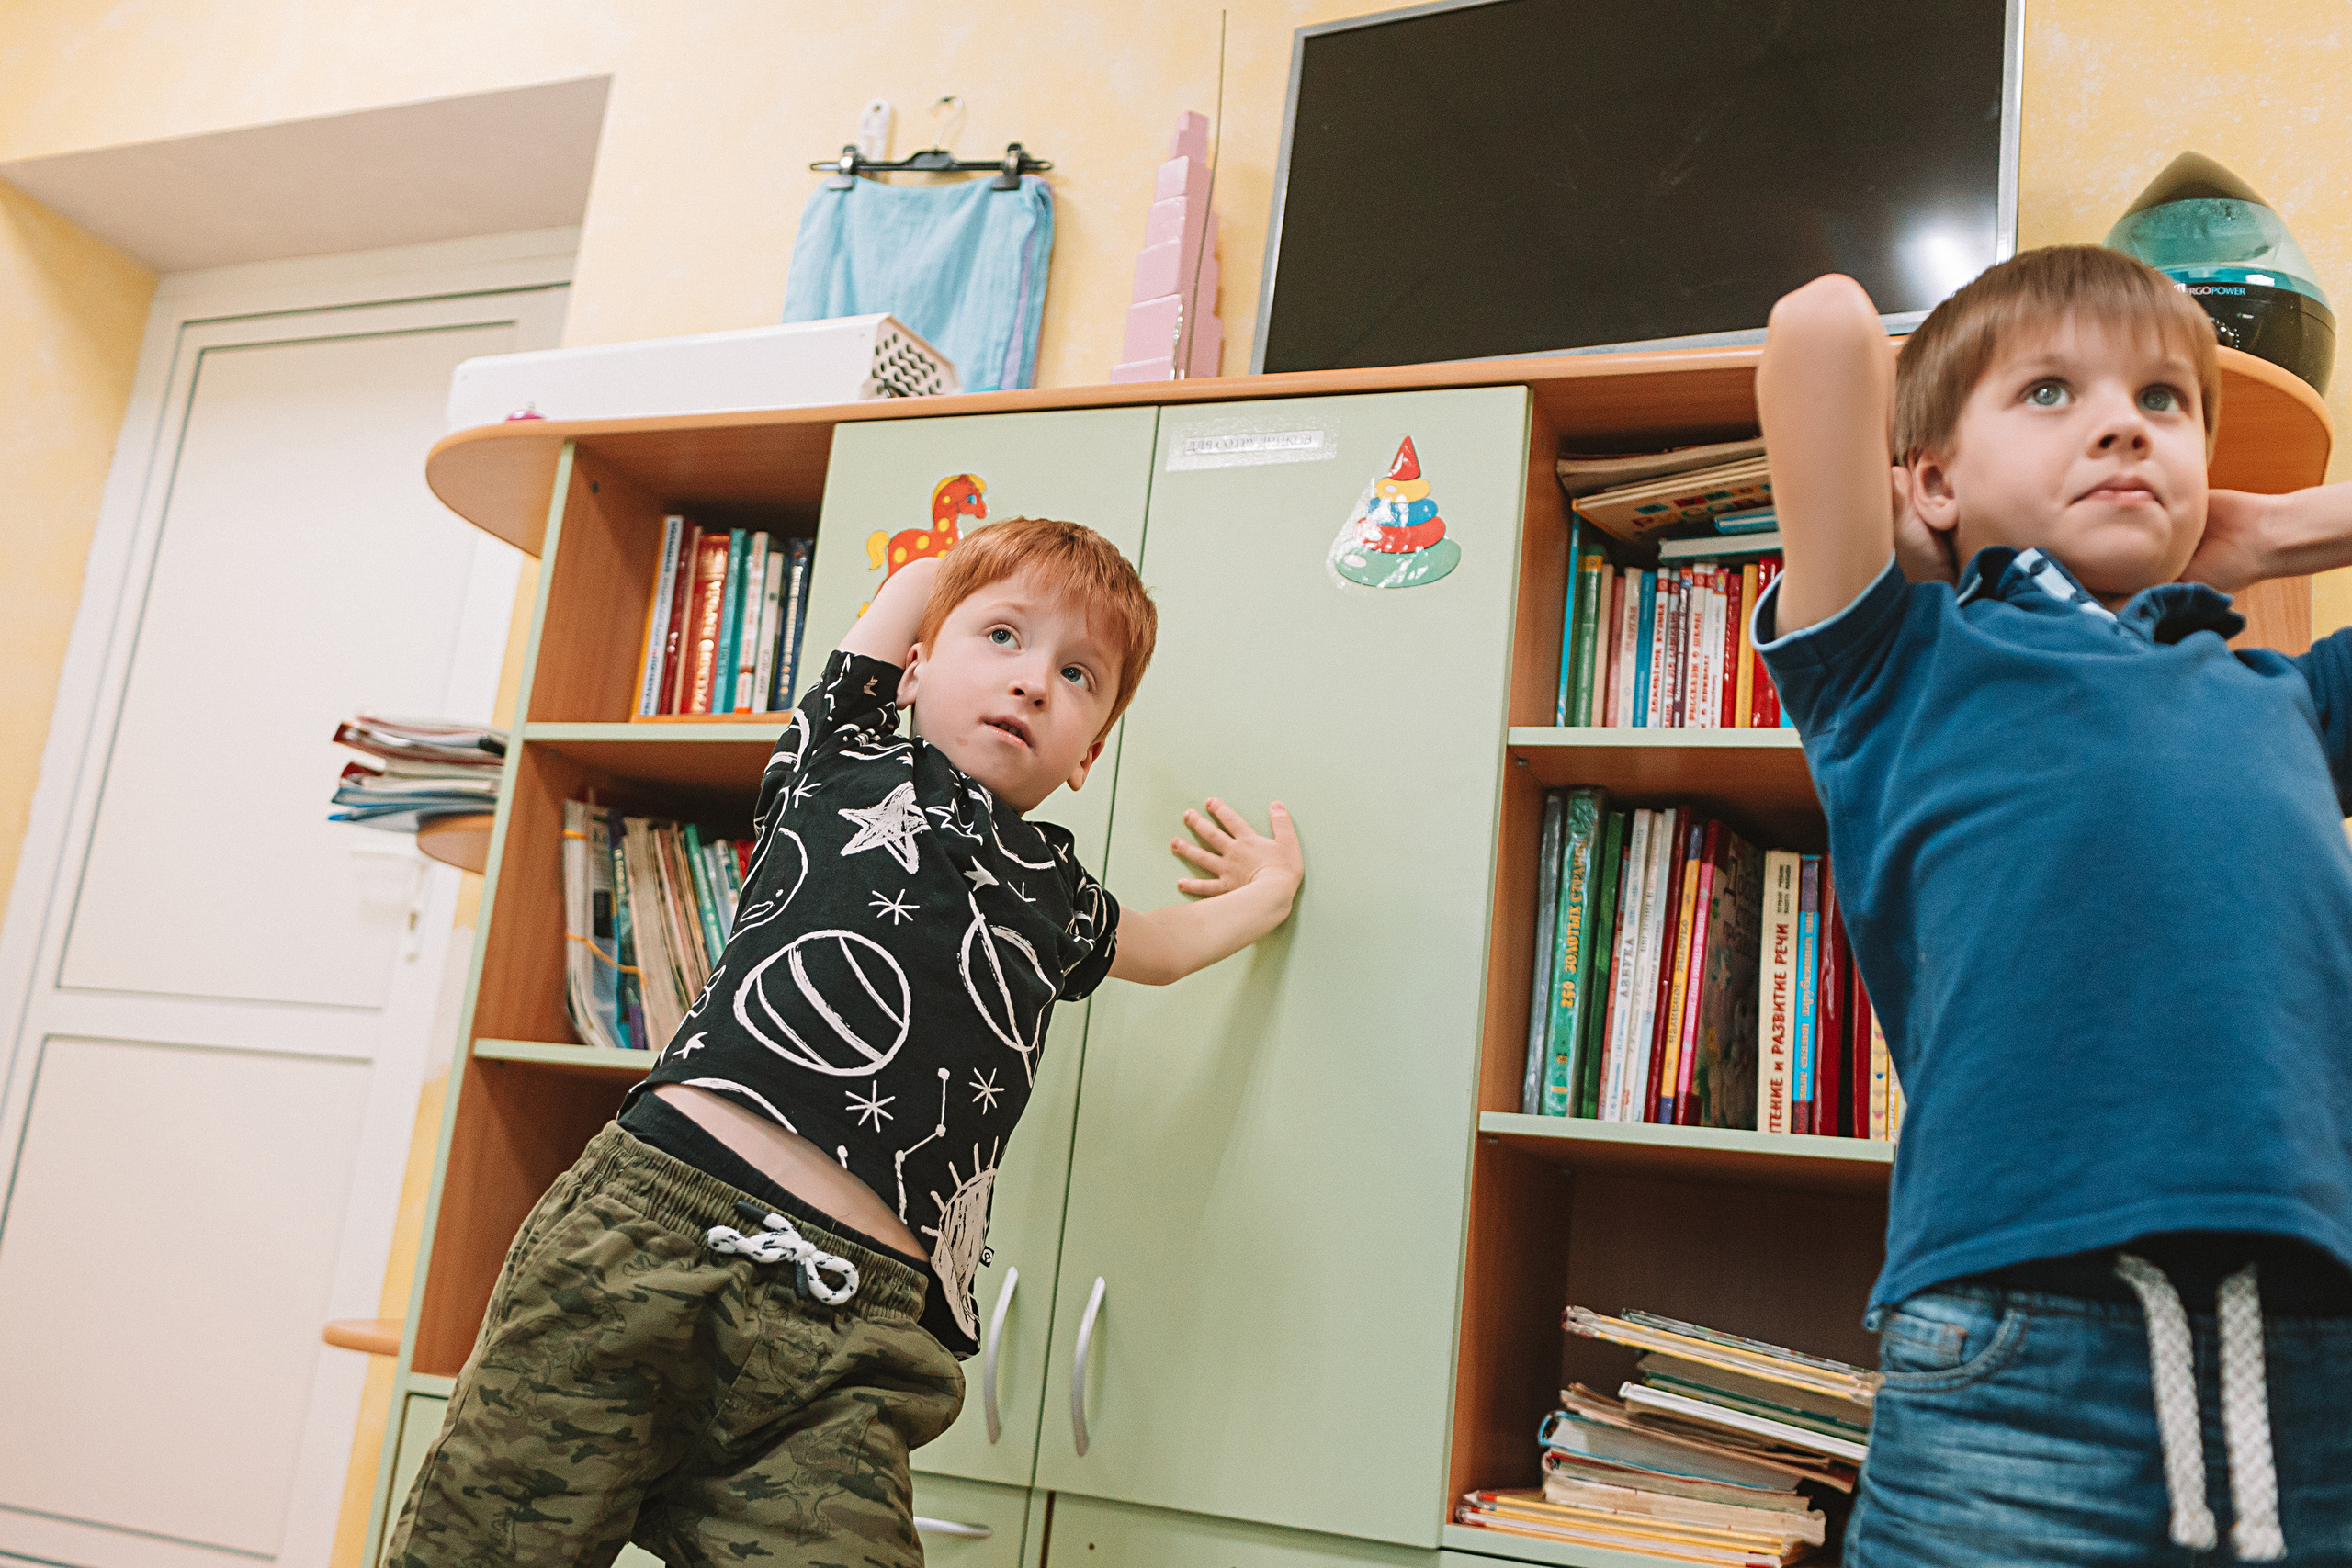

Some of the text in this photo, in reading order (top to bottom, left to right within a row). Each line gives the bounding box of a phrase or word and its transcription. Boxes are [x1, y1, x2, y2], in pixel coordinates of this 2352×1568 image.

[2186, 285, 2246, 296] RGOPOWER
[1563, 904, 1582, 974] ЗОЛОТЫХ
[1560, 979, 1577, 1008] 250
[1618, 935, 1634, 998] АЗБУКА
[1768, 922, 1789, 1134] ТЕНИЕ и РАЗВИТИЕ РЕЧИ
[1798, 1022, 1810, 1068] сказки
